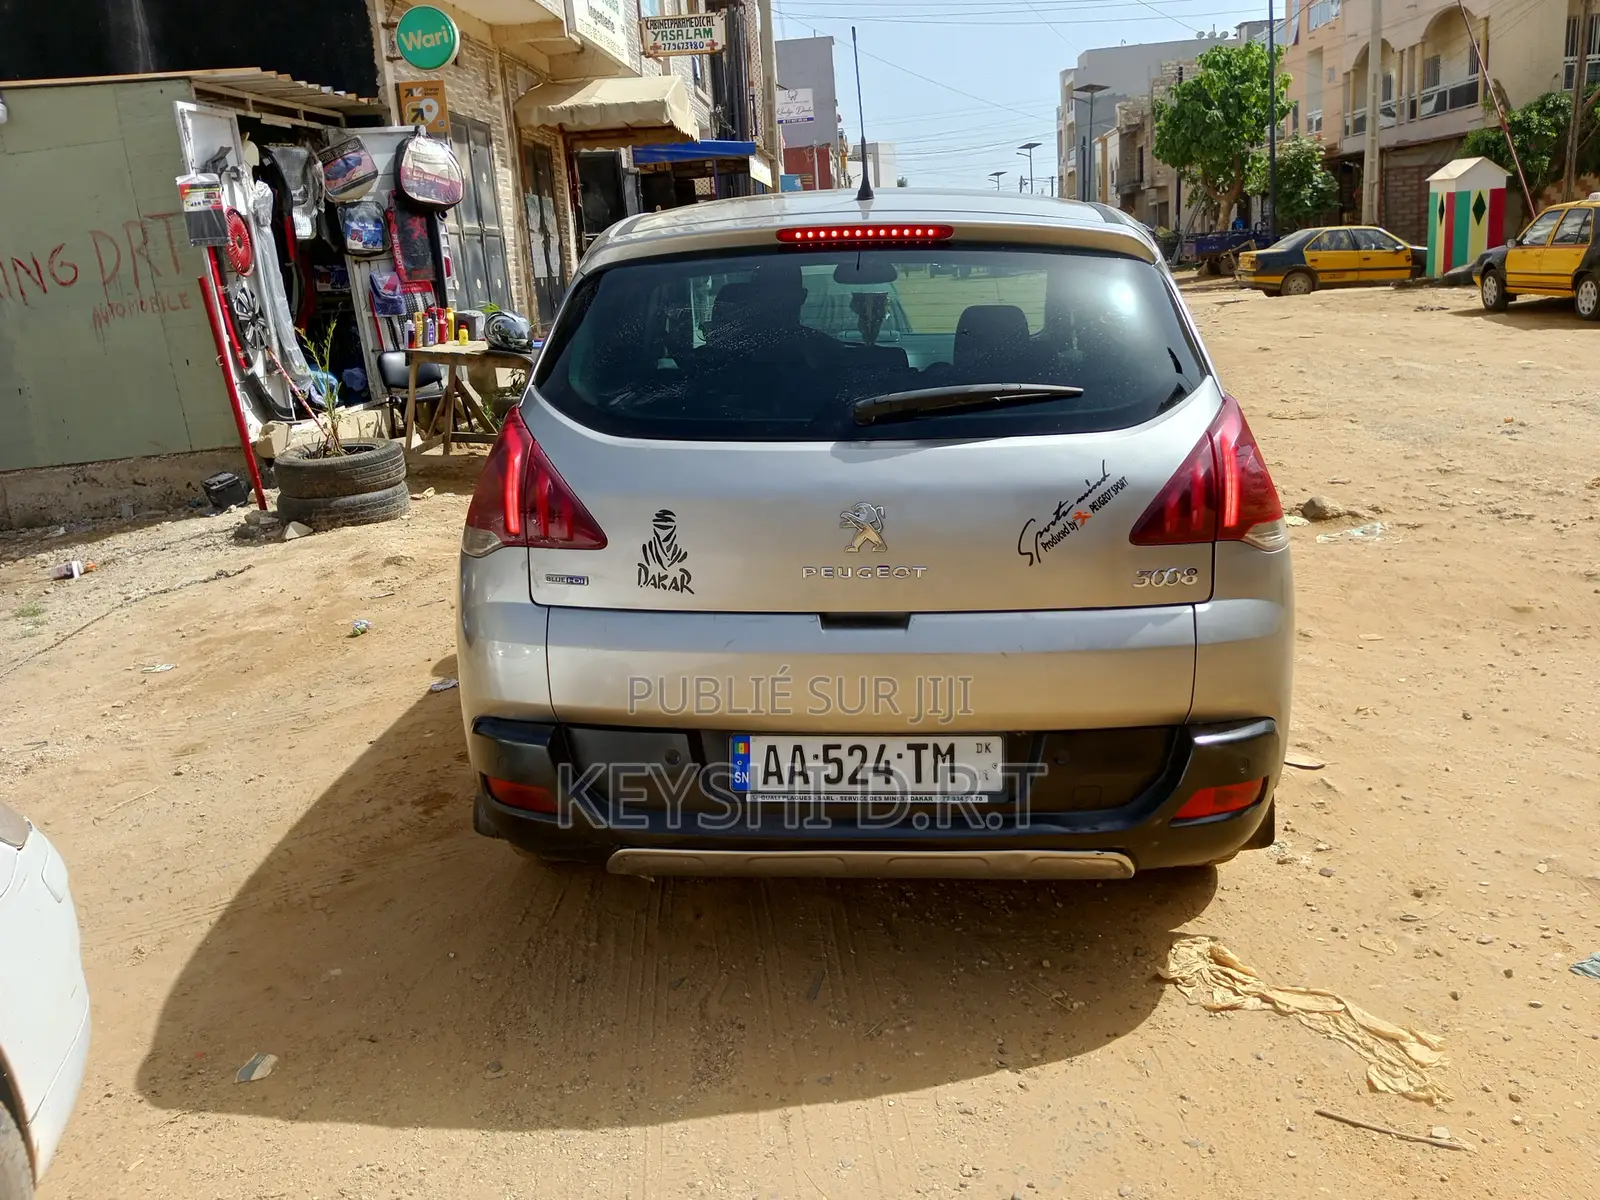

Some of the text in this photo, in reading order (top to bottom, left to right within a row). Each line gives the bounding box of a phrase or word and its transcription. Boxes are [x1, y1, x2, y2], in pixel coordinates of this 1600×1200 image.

[400, 25, 450, 52] Wari
[650, 27, 714, 42] YASALAM
[0, 211, 183, 307] ING DRT
[1040, 523, 1071, 552] Produced
[1088, 488, 1114, 514] PEUGEOT
[1110, 476, 1129, 496] SPORT
[637, 562, 696, 595] DAKAR
[801, 565, 928, 579] PEUGEOT
[1132, 567, 1199, 588] 3008
[975, 742, 992, 754] DK
[734, 771, 749, 784] SN
